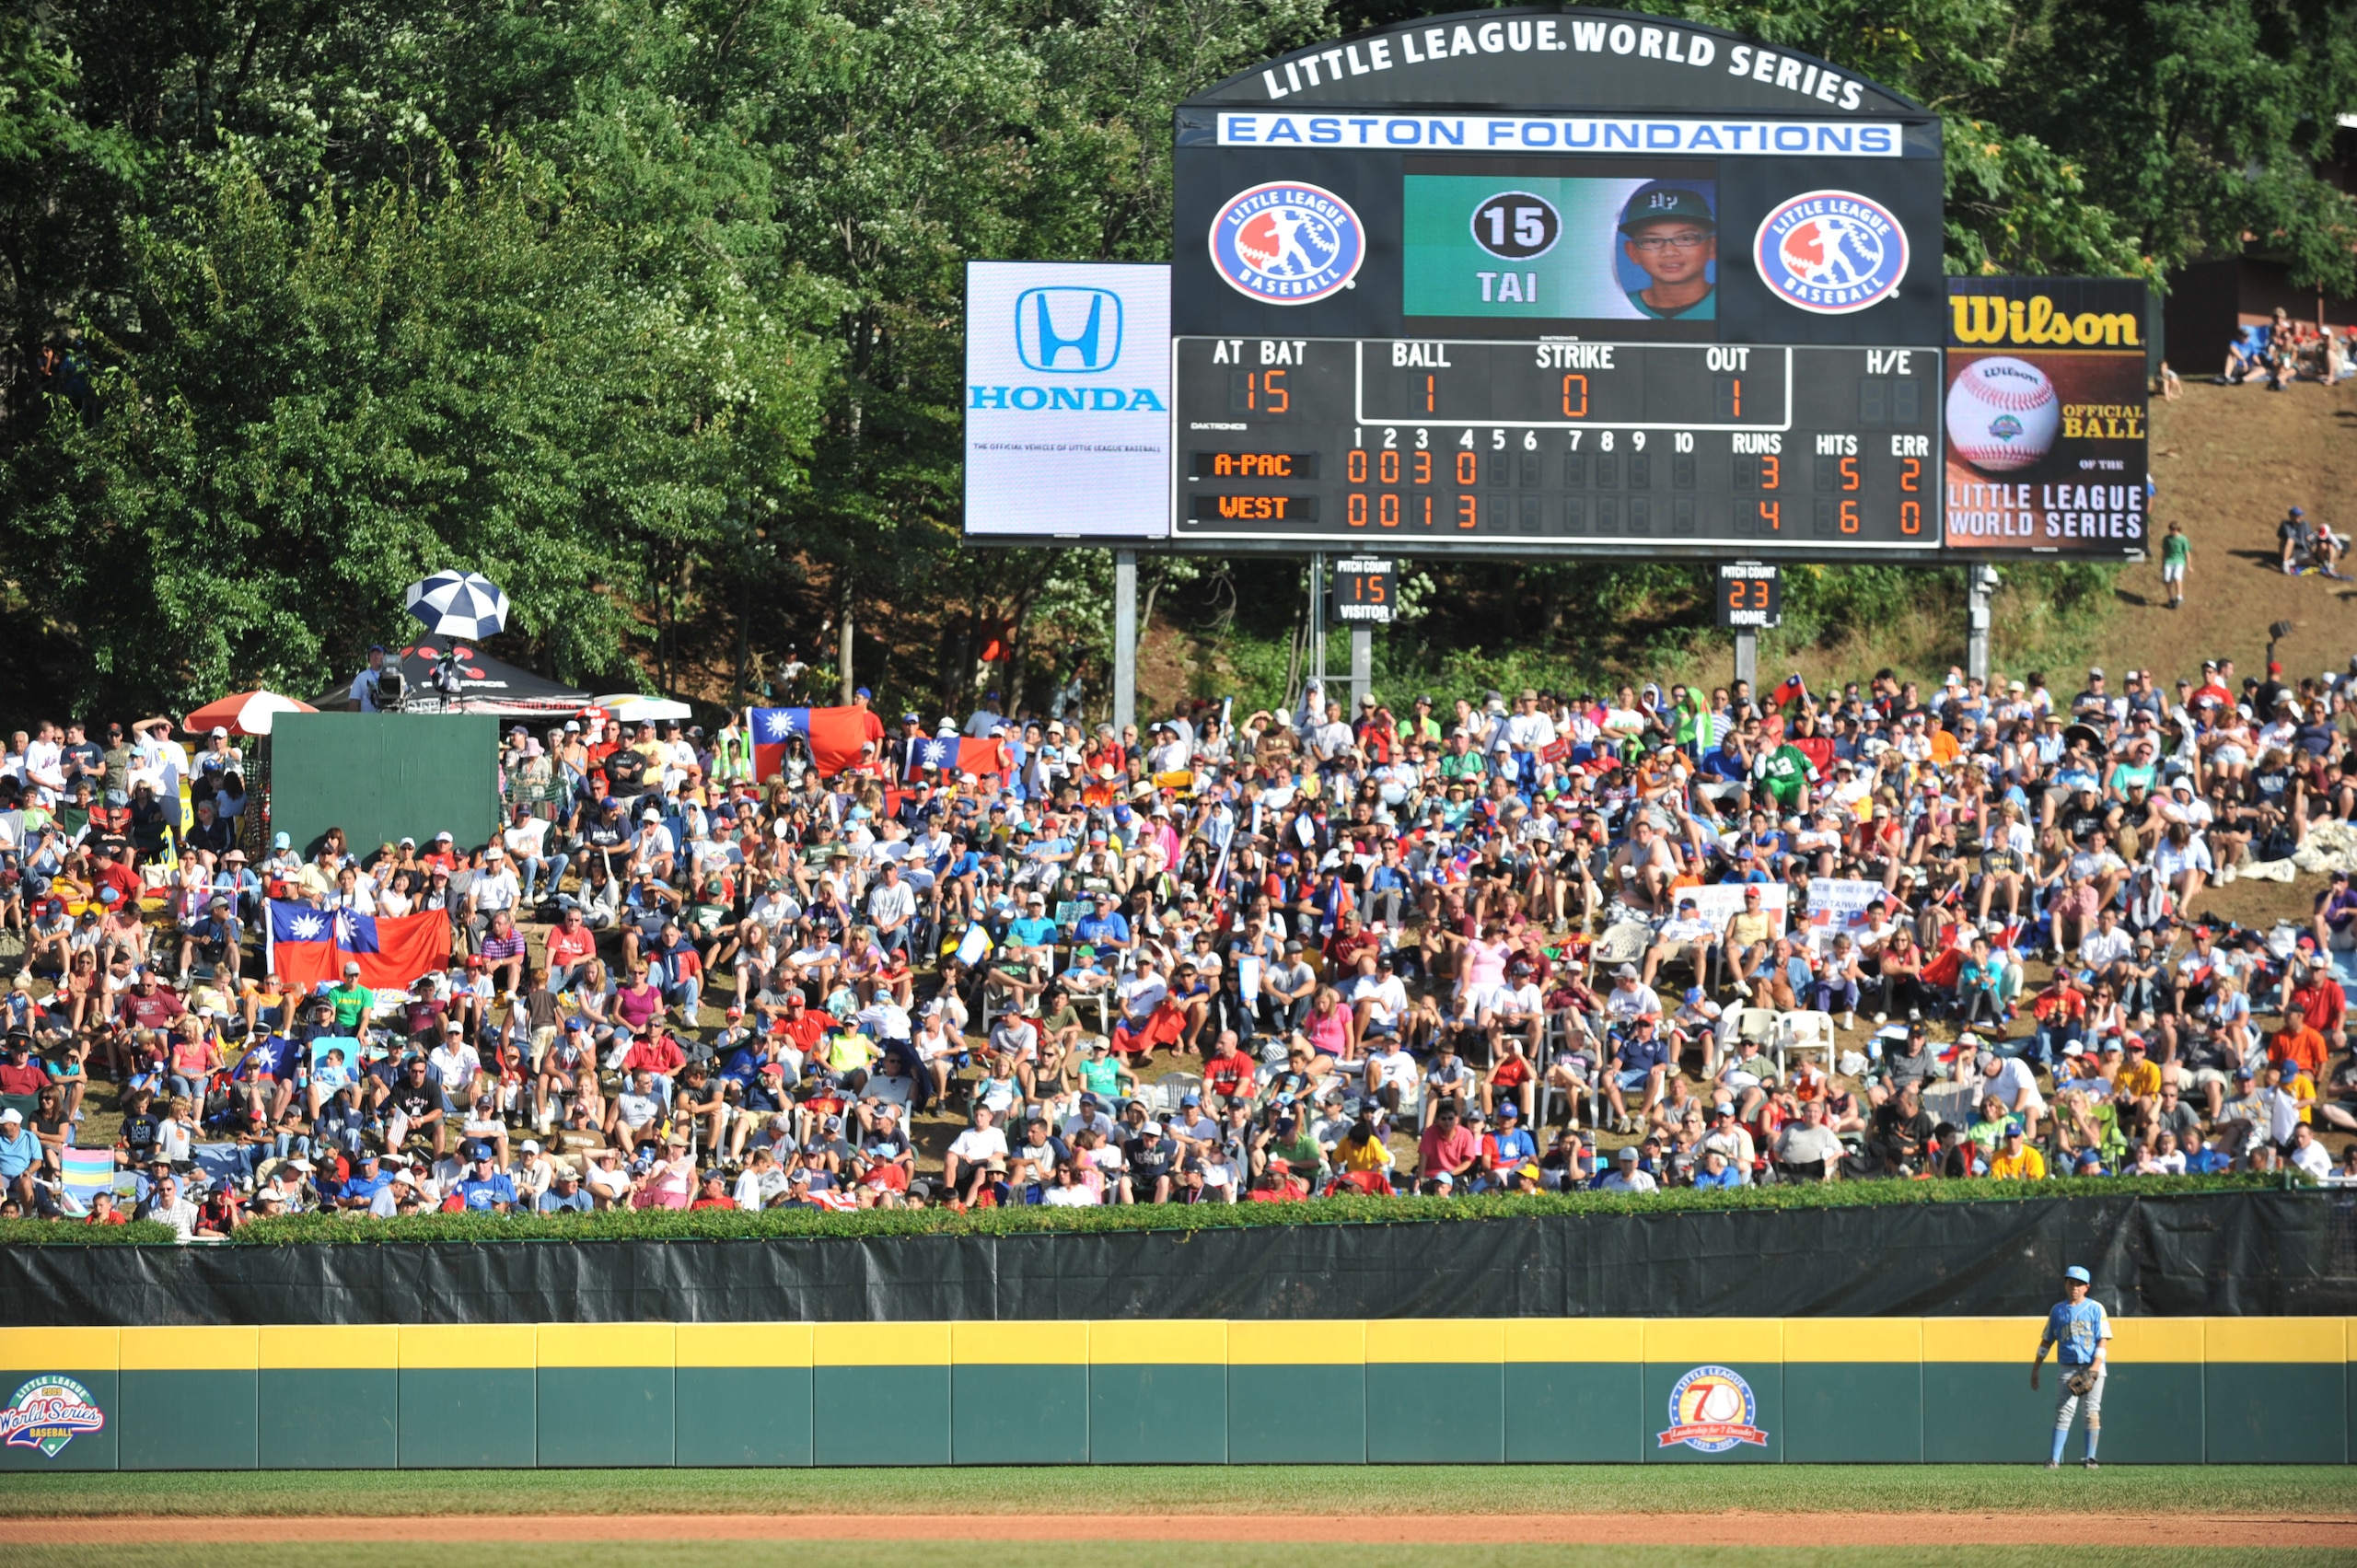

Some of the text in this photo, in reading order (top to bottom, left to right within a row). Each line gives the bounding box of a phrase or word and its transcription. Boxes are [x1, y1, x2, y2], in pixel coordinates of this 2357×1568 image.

[1262, 39, 1393, 99] LITTLE
[1572, 20, 1715, 67] WORLD
[1728, 45, 1864, 111] SERIES
[1226, 116, 1892, 153] EASTON FOUNDATIONS
[1227, 191, 1348, 227] LITTLE LEAGUE
[1771, 200, 1891, 237] LITTLE LEAGUE
[1483, 206, 1545, 247] 15
[1238, 268, 1341, 295] BASEBALL
[1476, 272, 1537, 303] TAI
[1783, 277, 1885, 304] BASEBALL
[1948, 295, 2140, 346] Wilson
[1213, 340, 1306, 365] AT BAT
[1392, 343, 1452, 367] BALL
[1535, 344, 1615, 370] STRIKE
[1706, 347, 1749, 372] OUT
[1866, 349, 1911, 376] H/E
[1983, 366, 2039, 385] Wilson
[969, 386, 1167, 412] HONDA
[1248, 370, 1289, 413] 15
[1426, 374, 1434, 413] 1
[1562, 374, 1588, 417] 0
[1733, 378, 1741, 417] 1
[2062, 404, 2145, 418] OFFICIAL
[1353, 426, 1929, 457] 1 2 3 4 5 6 7 8 9 10 RUNS HITS ERR
[2062, 417, 2145, 439] BALL
[1025, 443, 1054, 451] VEHICLE
[1214, 450, 1921, 492] A-PAC 0 0 3 0 3 5 2
[2079, 459, 2124, 470] OF THE
[1948, 482, 2142, 512] LITTLE LEAGUE
[1219, 496, 1289, 519] WEST
[1347, 494, 1367, 527] 0
[1380, 494, 1399, 528] 0
[1458, 494, 1476, 528] 3
[1759, 500, 1780, 530] 4
[1840, 500, 1860, 534] 6
[1900, 500, 1921, 535] 0
[1947, 511, 2142, 539] WORLD SERIES
[1337, 560, 1393, 574] PITCH COUNT
[1721, 565, 1777, 579] PITCH COUNT
[1355, 575, 1386, 603] 15
[1729, 580, 1769, 609] 23
[1340, 604, 1389, 620] VISITOR
[1729, 610, 1767, 625] HOME
[1073, 903, 1091, 913] ASIA
[1829, 900, 1867, 911] TAIWAN
[16, 1376, 87, 1399] LITTLE LEAGUE
[41, 1387, 63, 1397] 2009
[1678, 1368, 1745, 1391] LITTLE LEAGUE
[0, 1400, 98, 1434] World Series
[29, 1427, 74, 1438] BASEBALL
